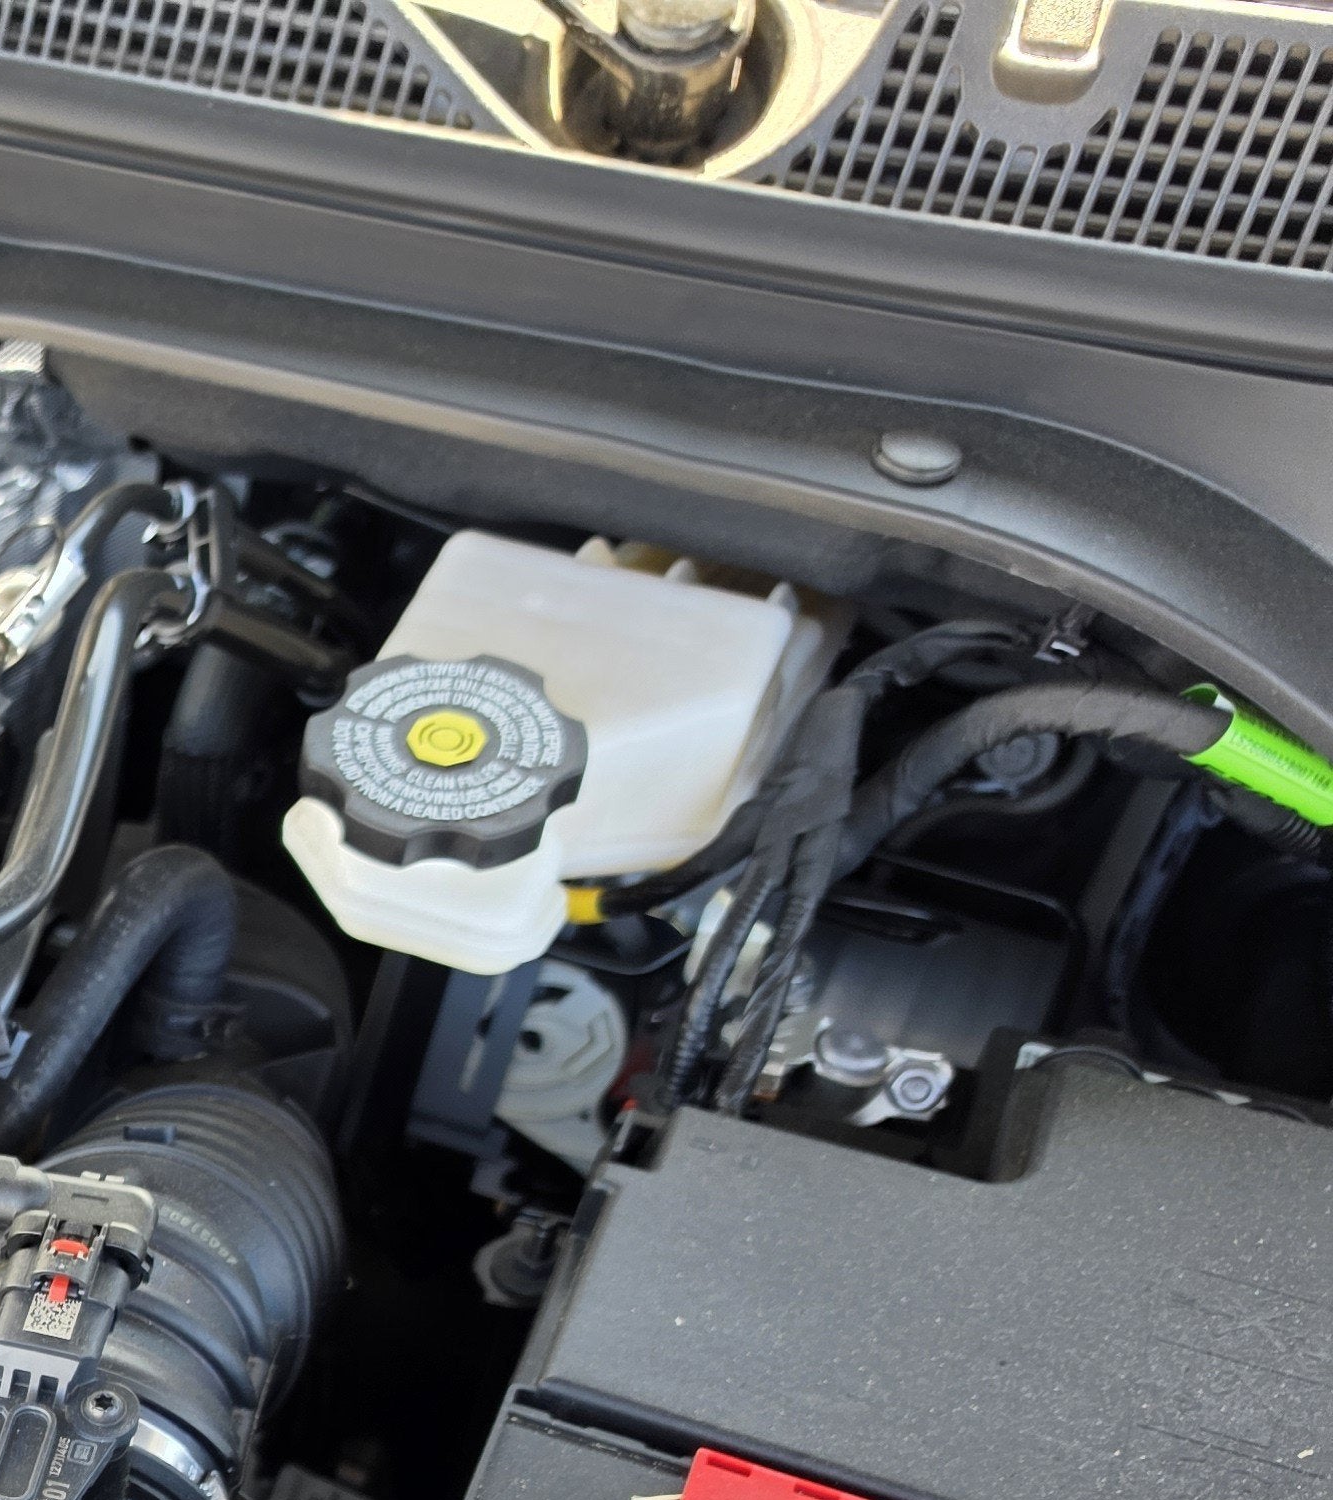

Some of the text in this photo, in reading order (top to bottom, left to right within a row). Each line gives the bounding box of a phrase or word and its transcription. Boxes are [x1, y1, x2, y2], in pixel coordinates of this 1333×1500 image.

[406, 767, 455, 790] CLEAN
[353, 775, 395, 807] FROM
[403, 801, 463, 821] SEALED
